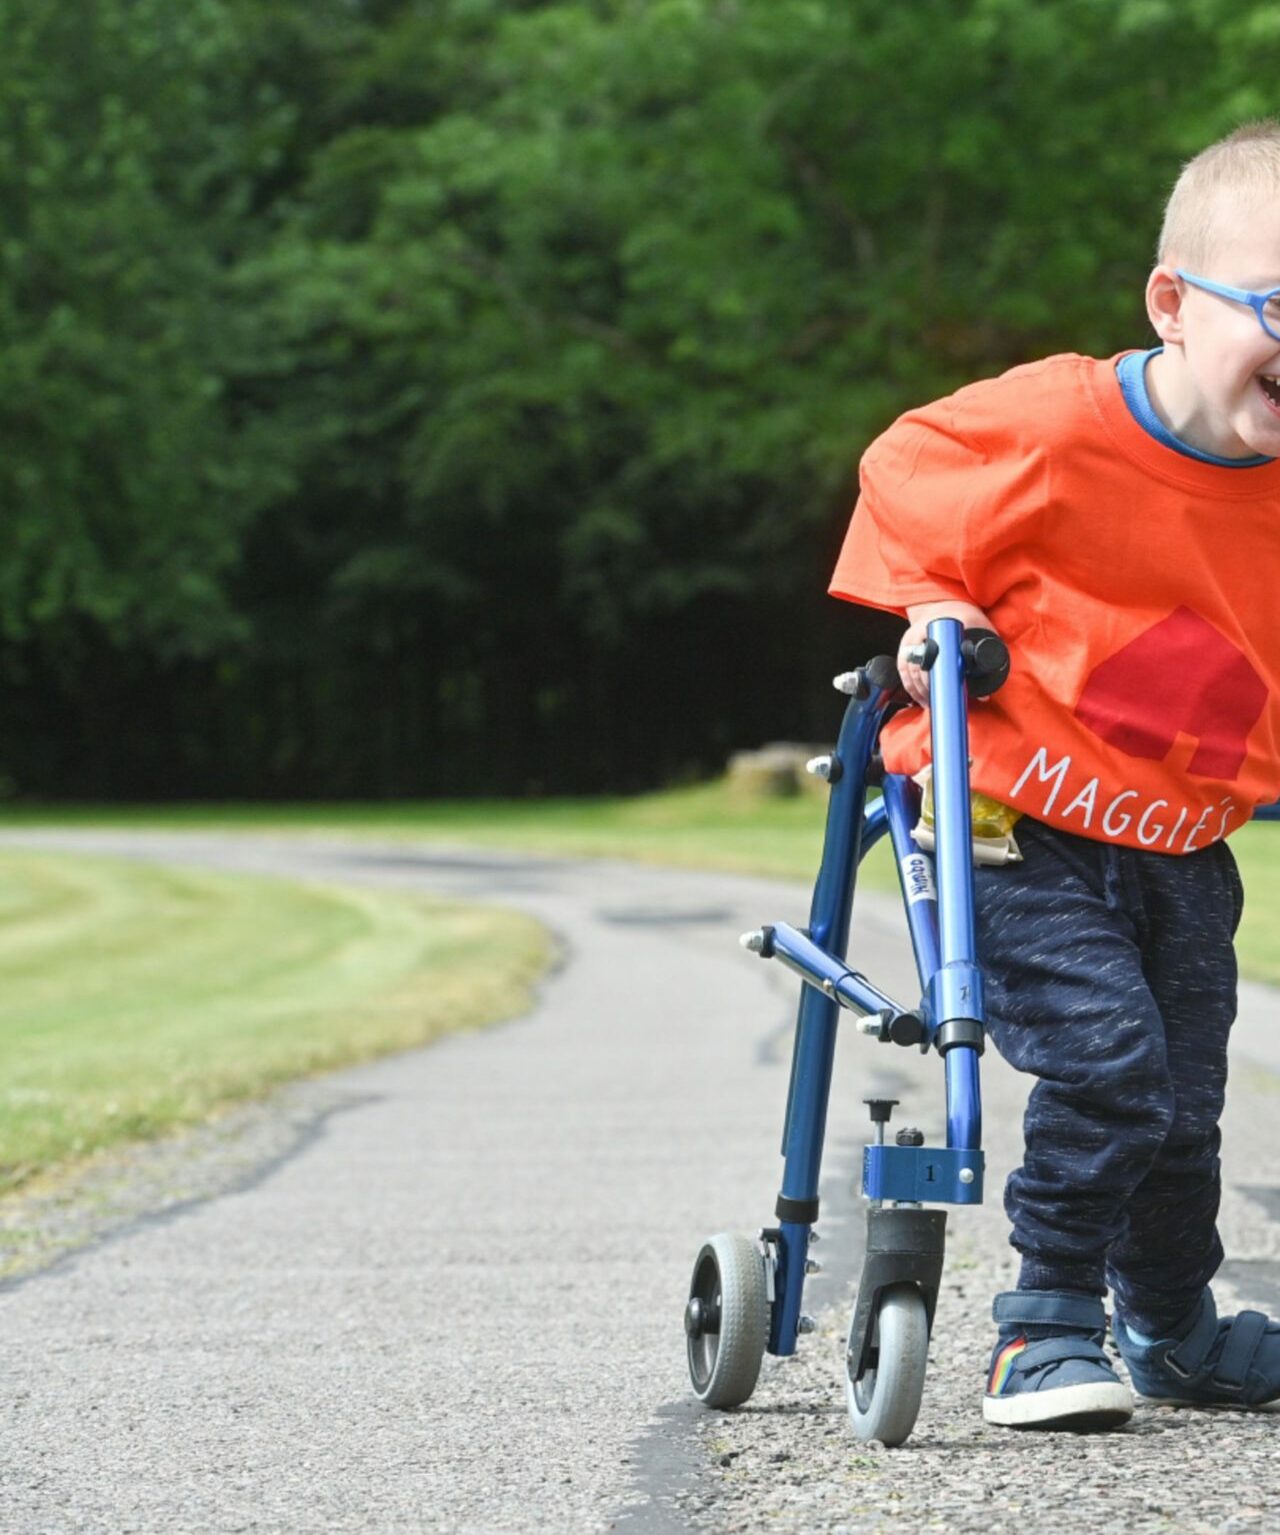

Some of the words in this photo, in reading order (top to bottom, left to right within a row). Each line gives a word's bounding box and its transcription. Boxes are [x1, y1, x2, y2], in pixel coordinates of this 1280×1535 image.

[1009, 746, 1235, 853] MAGGIE'S
[906, 859, 929, 896] Nimbo
[925, 1164, 935, 1182] 1
